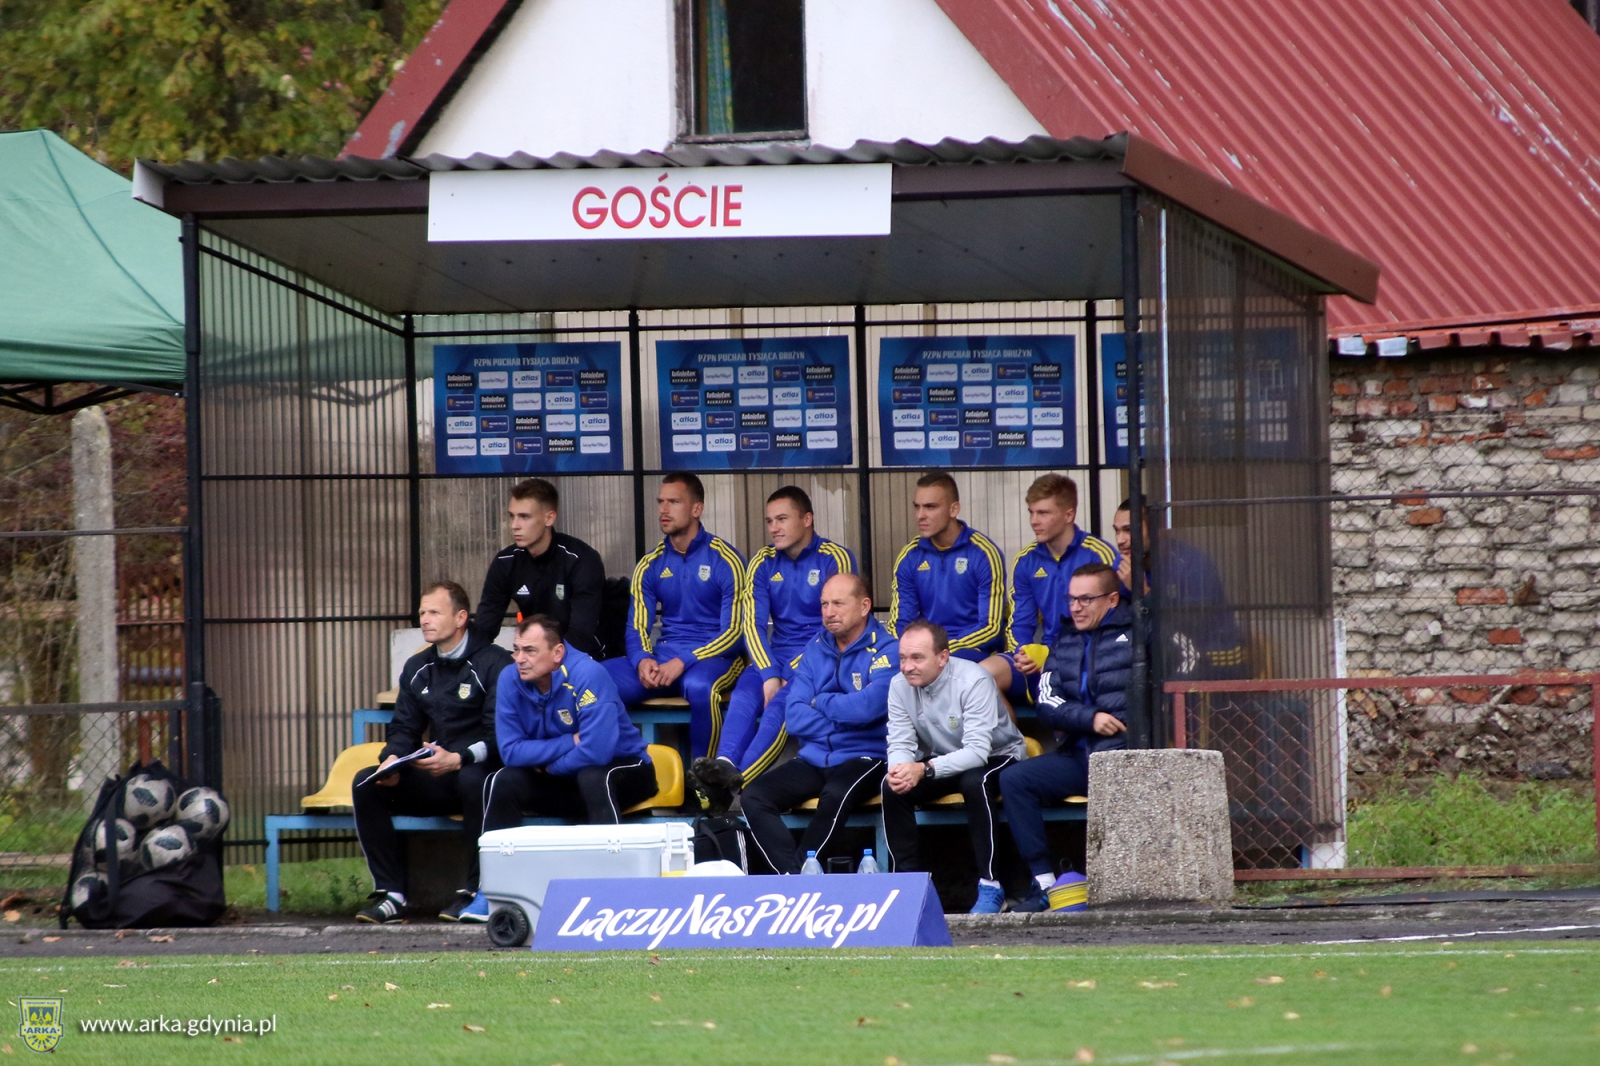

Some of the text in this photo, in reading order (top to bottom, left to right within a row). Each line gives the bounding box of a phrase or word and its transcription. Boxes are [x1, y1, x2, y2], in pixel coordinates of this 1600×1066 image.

[572, 172, 743, 229] GOŚCIE
[698, 354, 716, 362] PZPN
[718, 354, 747, 362] PUCHAR
[922, 351, 941, 359] PZPN
[942, 350, 971, 358] PUCHAR
[474, 358, 491, 367] PZPN
[493, 358, 521, 366] PUCHAR
[557, 889, 900, 950] LaczyNasPilka.pl
